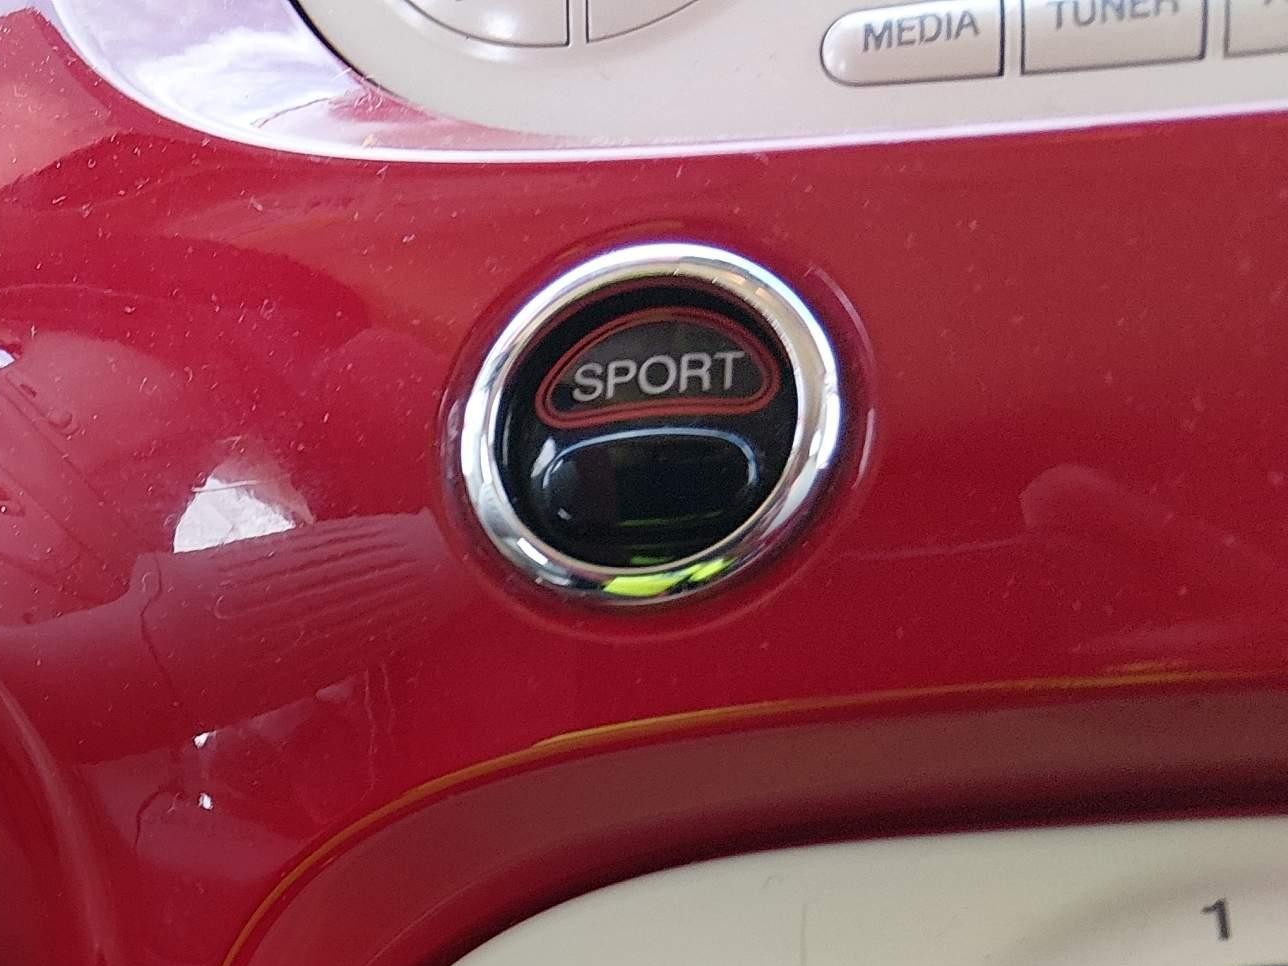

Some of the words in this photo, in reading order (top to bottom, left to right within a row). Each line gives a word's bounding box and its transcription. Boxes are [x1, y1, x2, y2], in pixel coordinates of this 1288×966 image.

[862, 10, 980, 52] MEDIA
[572, 351, 745, 401] SPORT
[1202, 898, 1231, 940] 1
